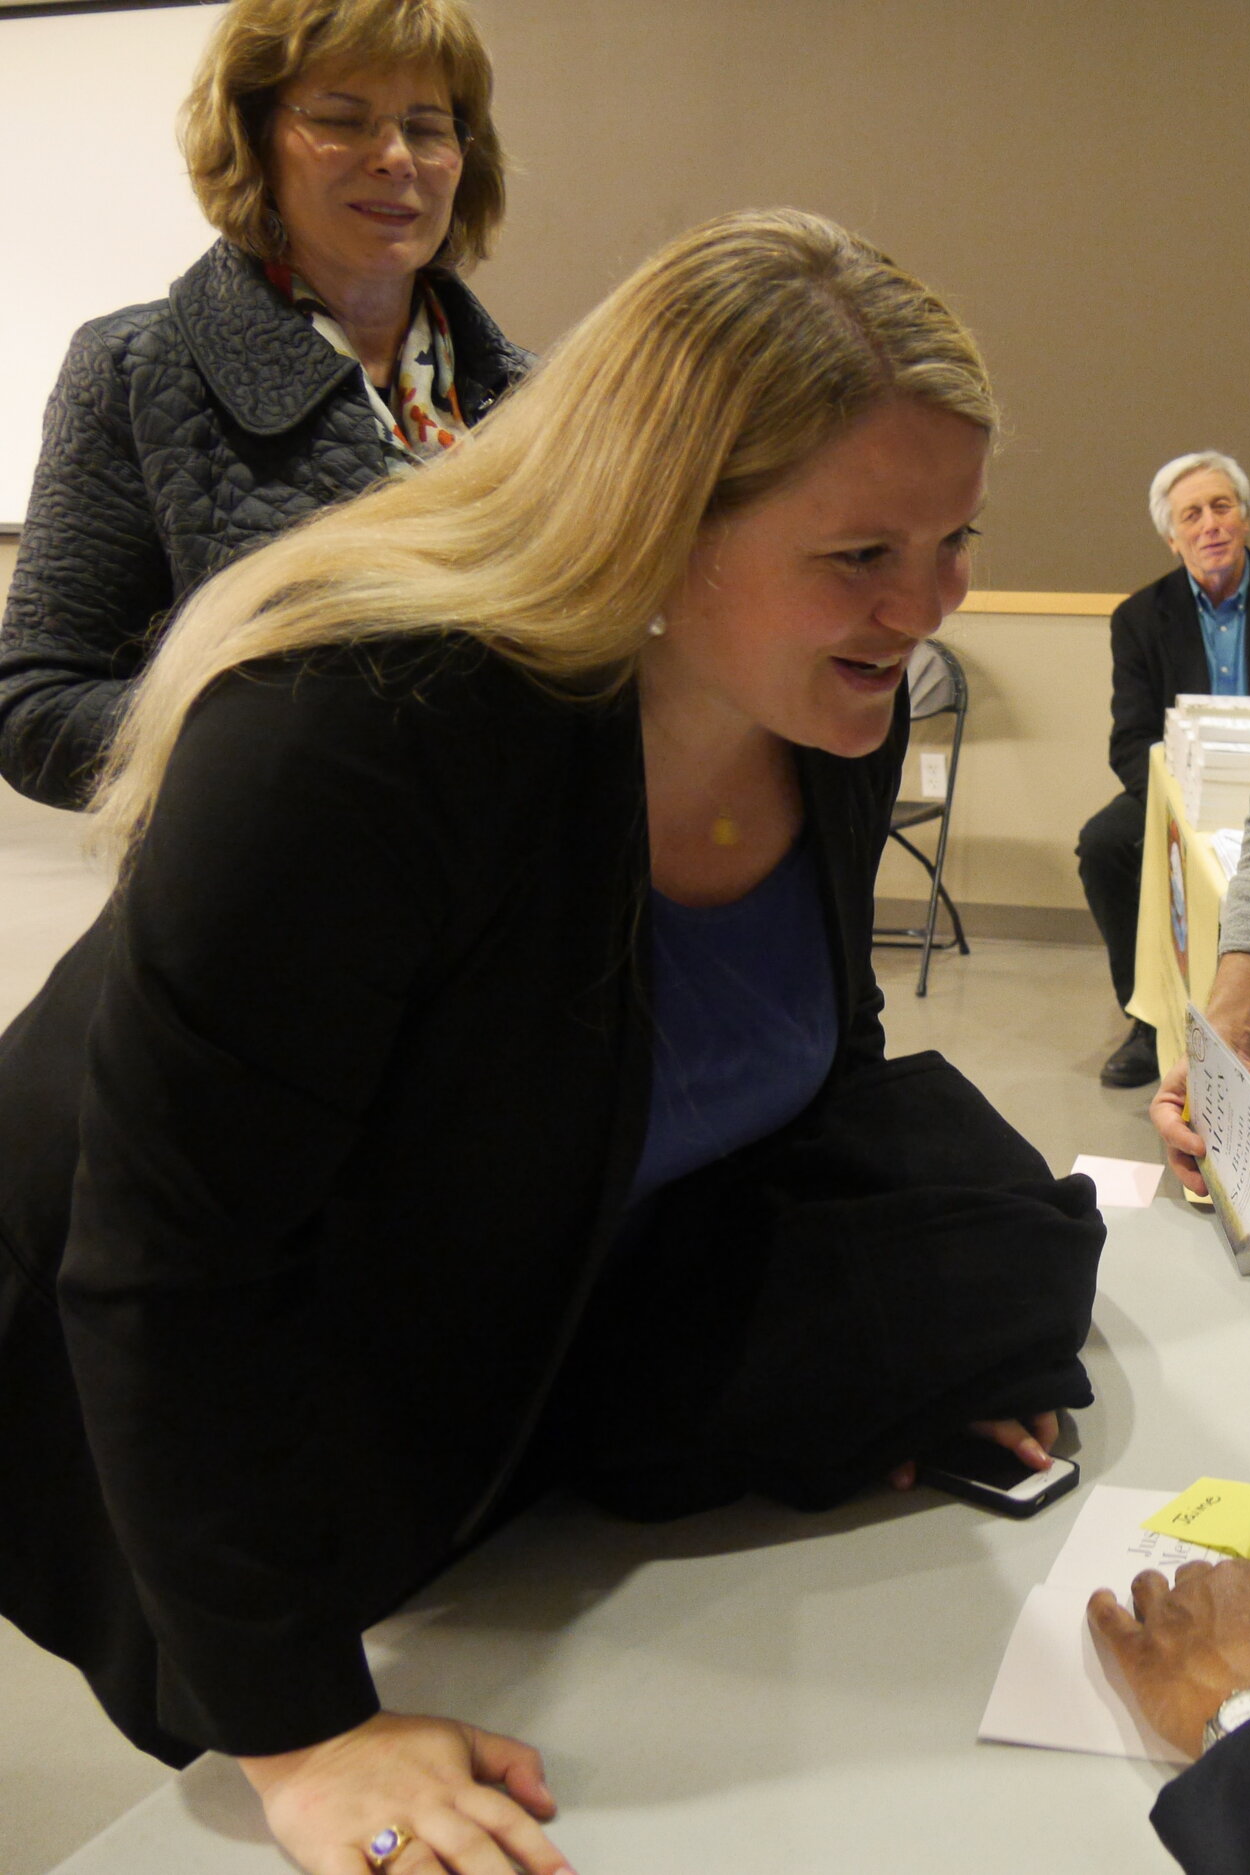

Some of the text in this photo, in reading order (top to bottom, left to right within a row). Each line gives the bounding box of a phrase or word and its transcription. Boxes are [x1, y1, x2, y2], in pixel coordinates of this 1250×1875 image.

[1202, 1068, 1214, 1134] Just
[1211, 1074, 1230, 1158] Mercy
[1232, 1115, 1245, 1173] Bryan
[1127, 1530, 1161, 1558] Jus
